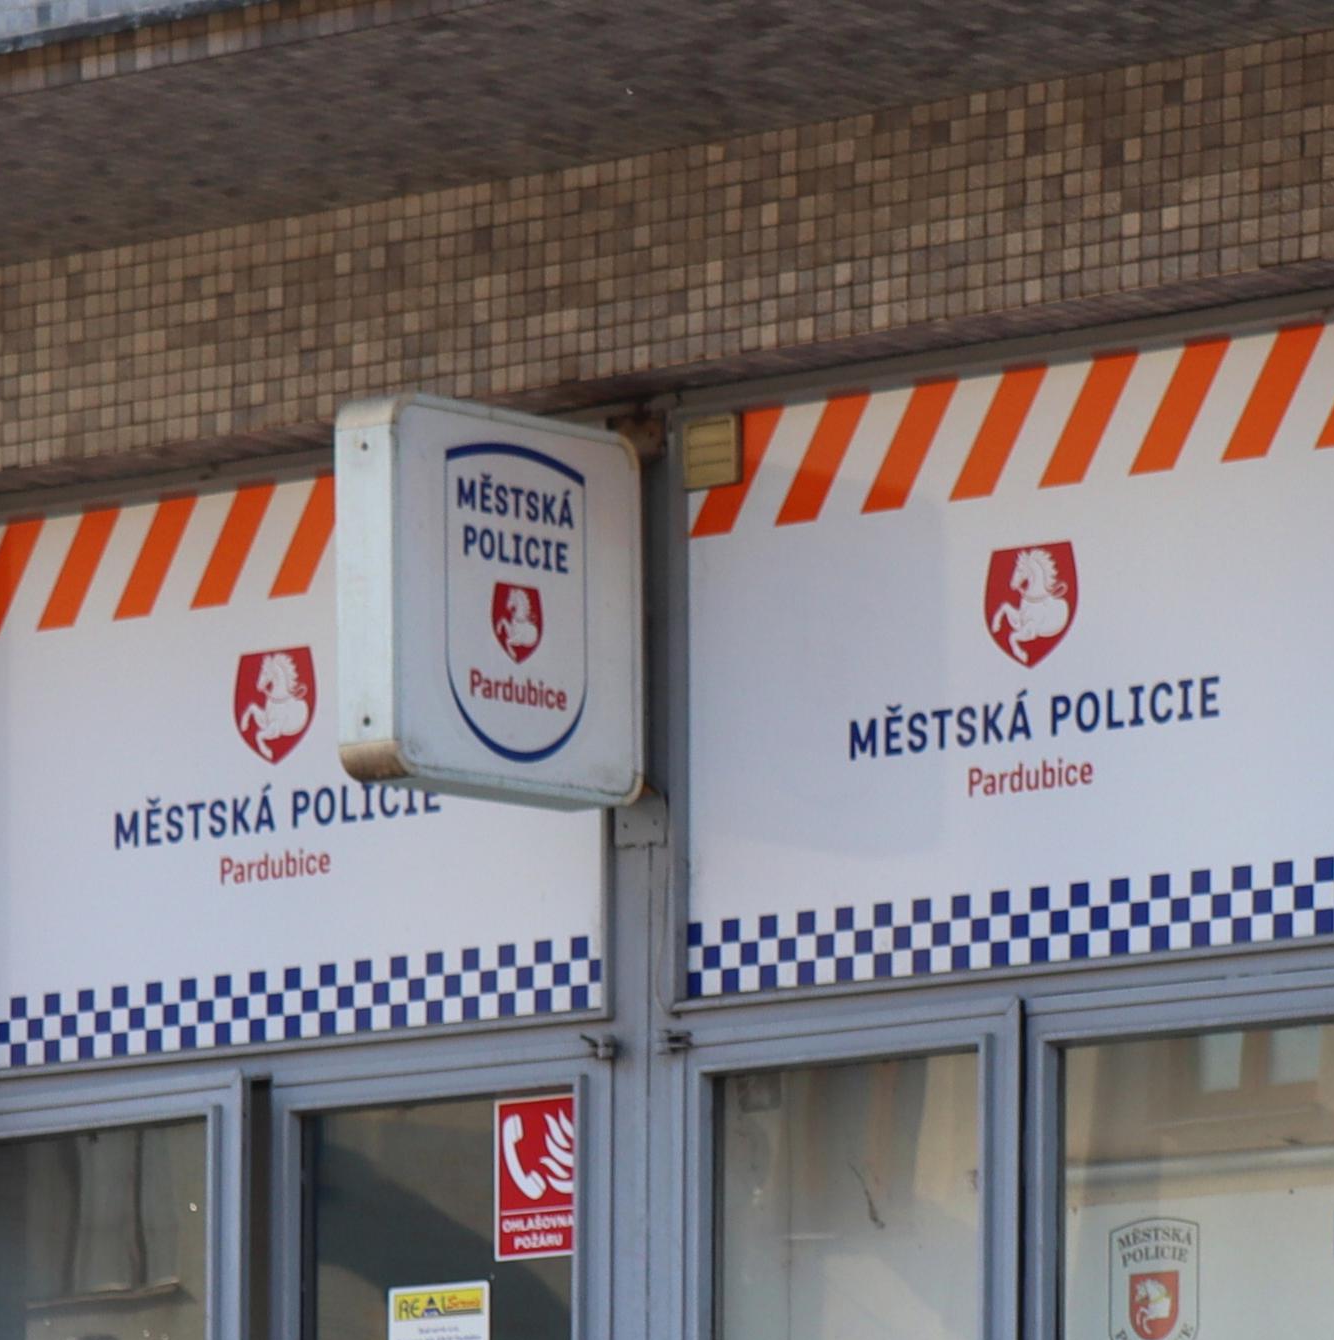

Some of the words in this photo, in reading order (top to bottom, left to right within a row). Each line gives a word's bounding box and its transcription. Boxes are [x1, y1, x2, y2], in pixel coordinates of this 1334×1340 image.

[457, 473, 574, 530] MĚSTSKÁ
[463, 524, 569, 574] POLICIE
[470, 667, 567, 711] Pardubice
[849, 688, 1032, 761] MĚSTSKÁ
[1050, 675, 1220, 737] POLICIE
[968, 758, 1094, 798] Pardubice
[114, 784, 275, 850] MĚSTSKÁ
[292, 782, 441, 829] POLICIE
[220, 848, 331, 885] Pardubice
[502, 1213, 574, 1233] OHLAŠOVNA
[513, 1232, 563, 1250] POŽÁRU
[1118, 1227, 1193, 1249] MĚSTSKÁ
[1121, 1246, 1188, 1268] POLICIE
